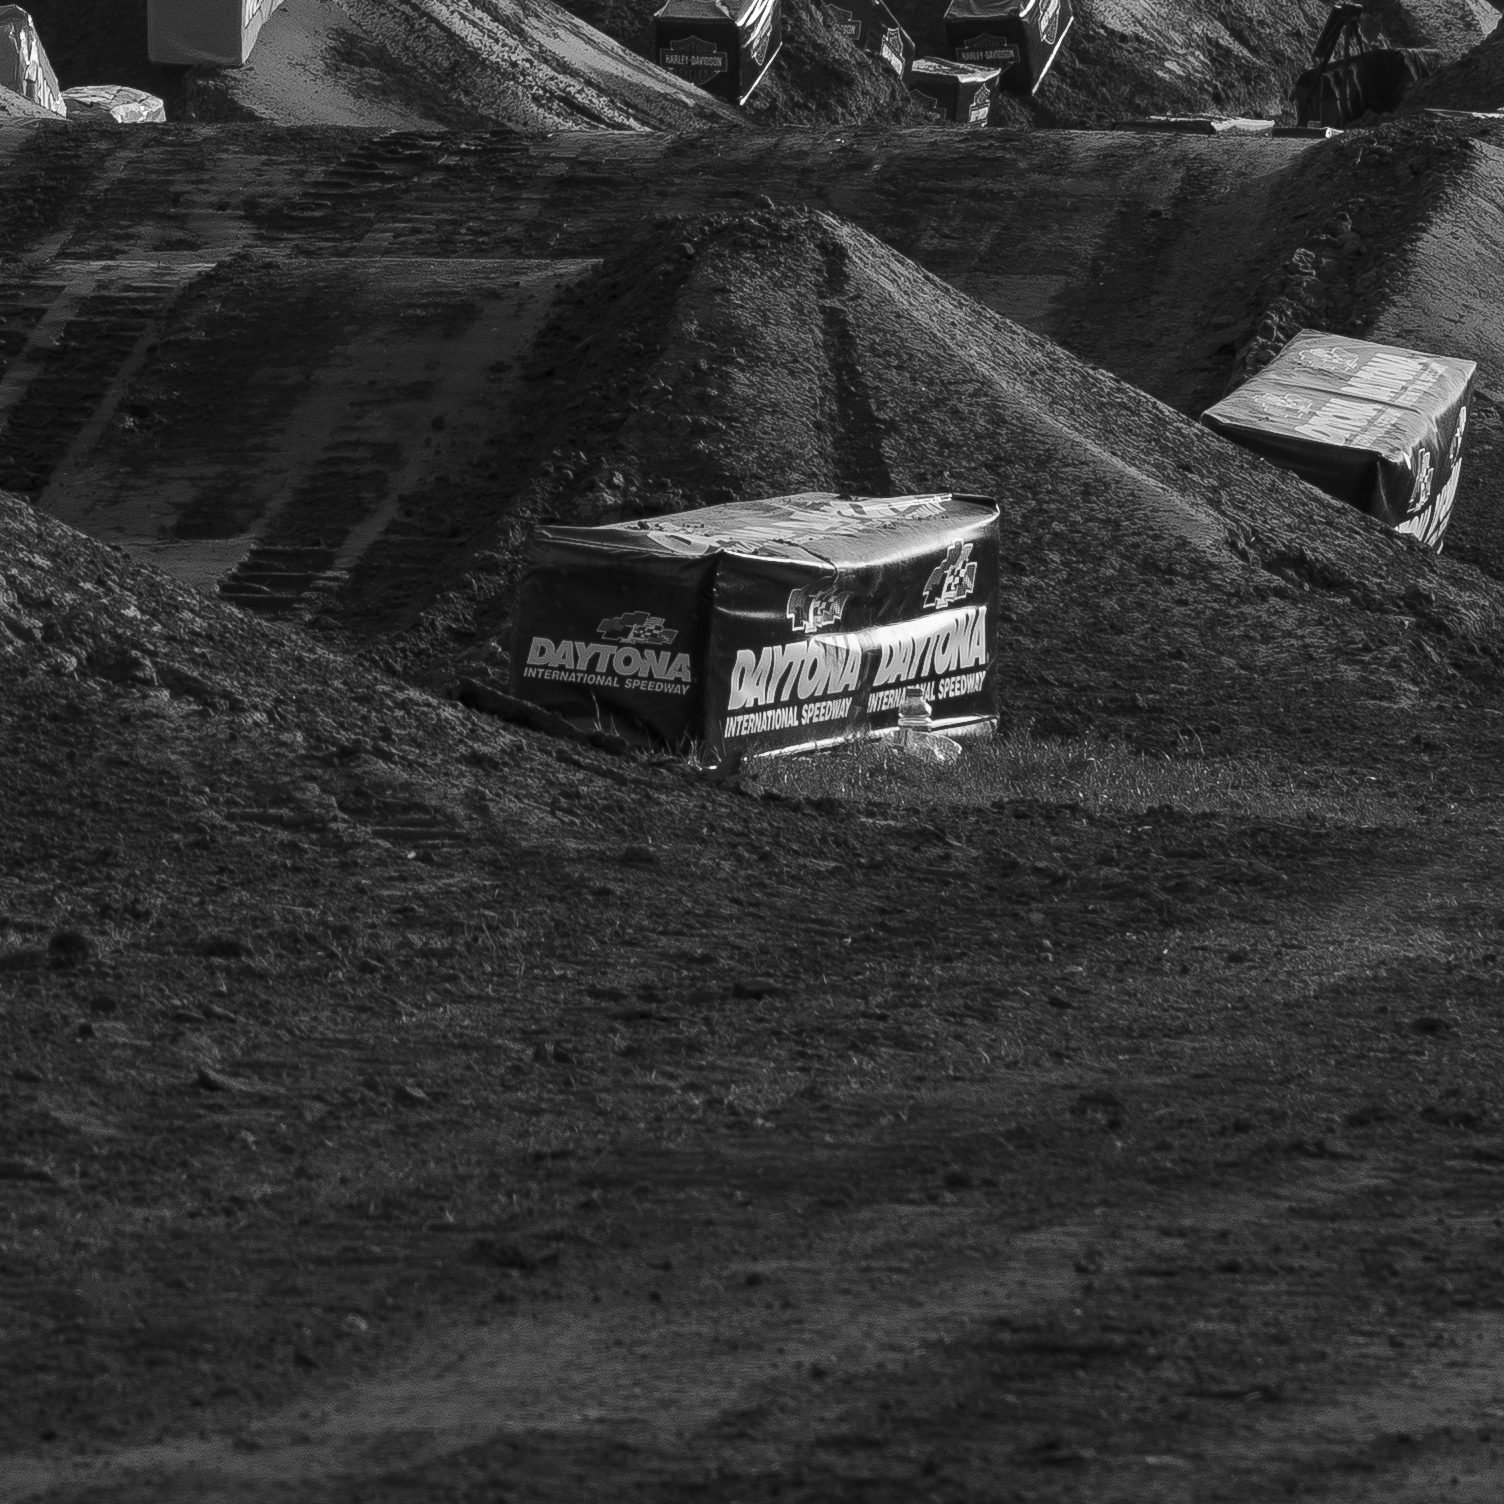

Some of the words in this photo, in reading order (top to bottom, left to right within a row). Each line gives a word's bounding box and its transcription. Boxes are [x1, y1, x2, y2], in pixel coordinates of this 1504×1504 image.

[665, 55, 723, 68] HARLEY-DAVIDSON
[526, 636, 691, 682] DAYTONA
[872, 606, 989, 688] DAYTONA
[523, 665, 620, 689] INTERNATIONAL
[624, 679, 690, 696] SPEEDWAY
[729, 638, 862, 711] DAYTONA
[938, 671, 987, 704] SPEEDWAY
[724, 704, 798, 738] INTERNATIONAL
[801, 697, 853, 724] SPEEDWAY
